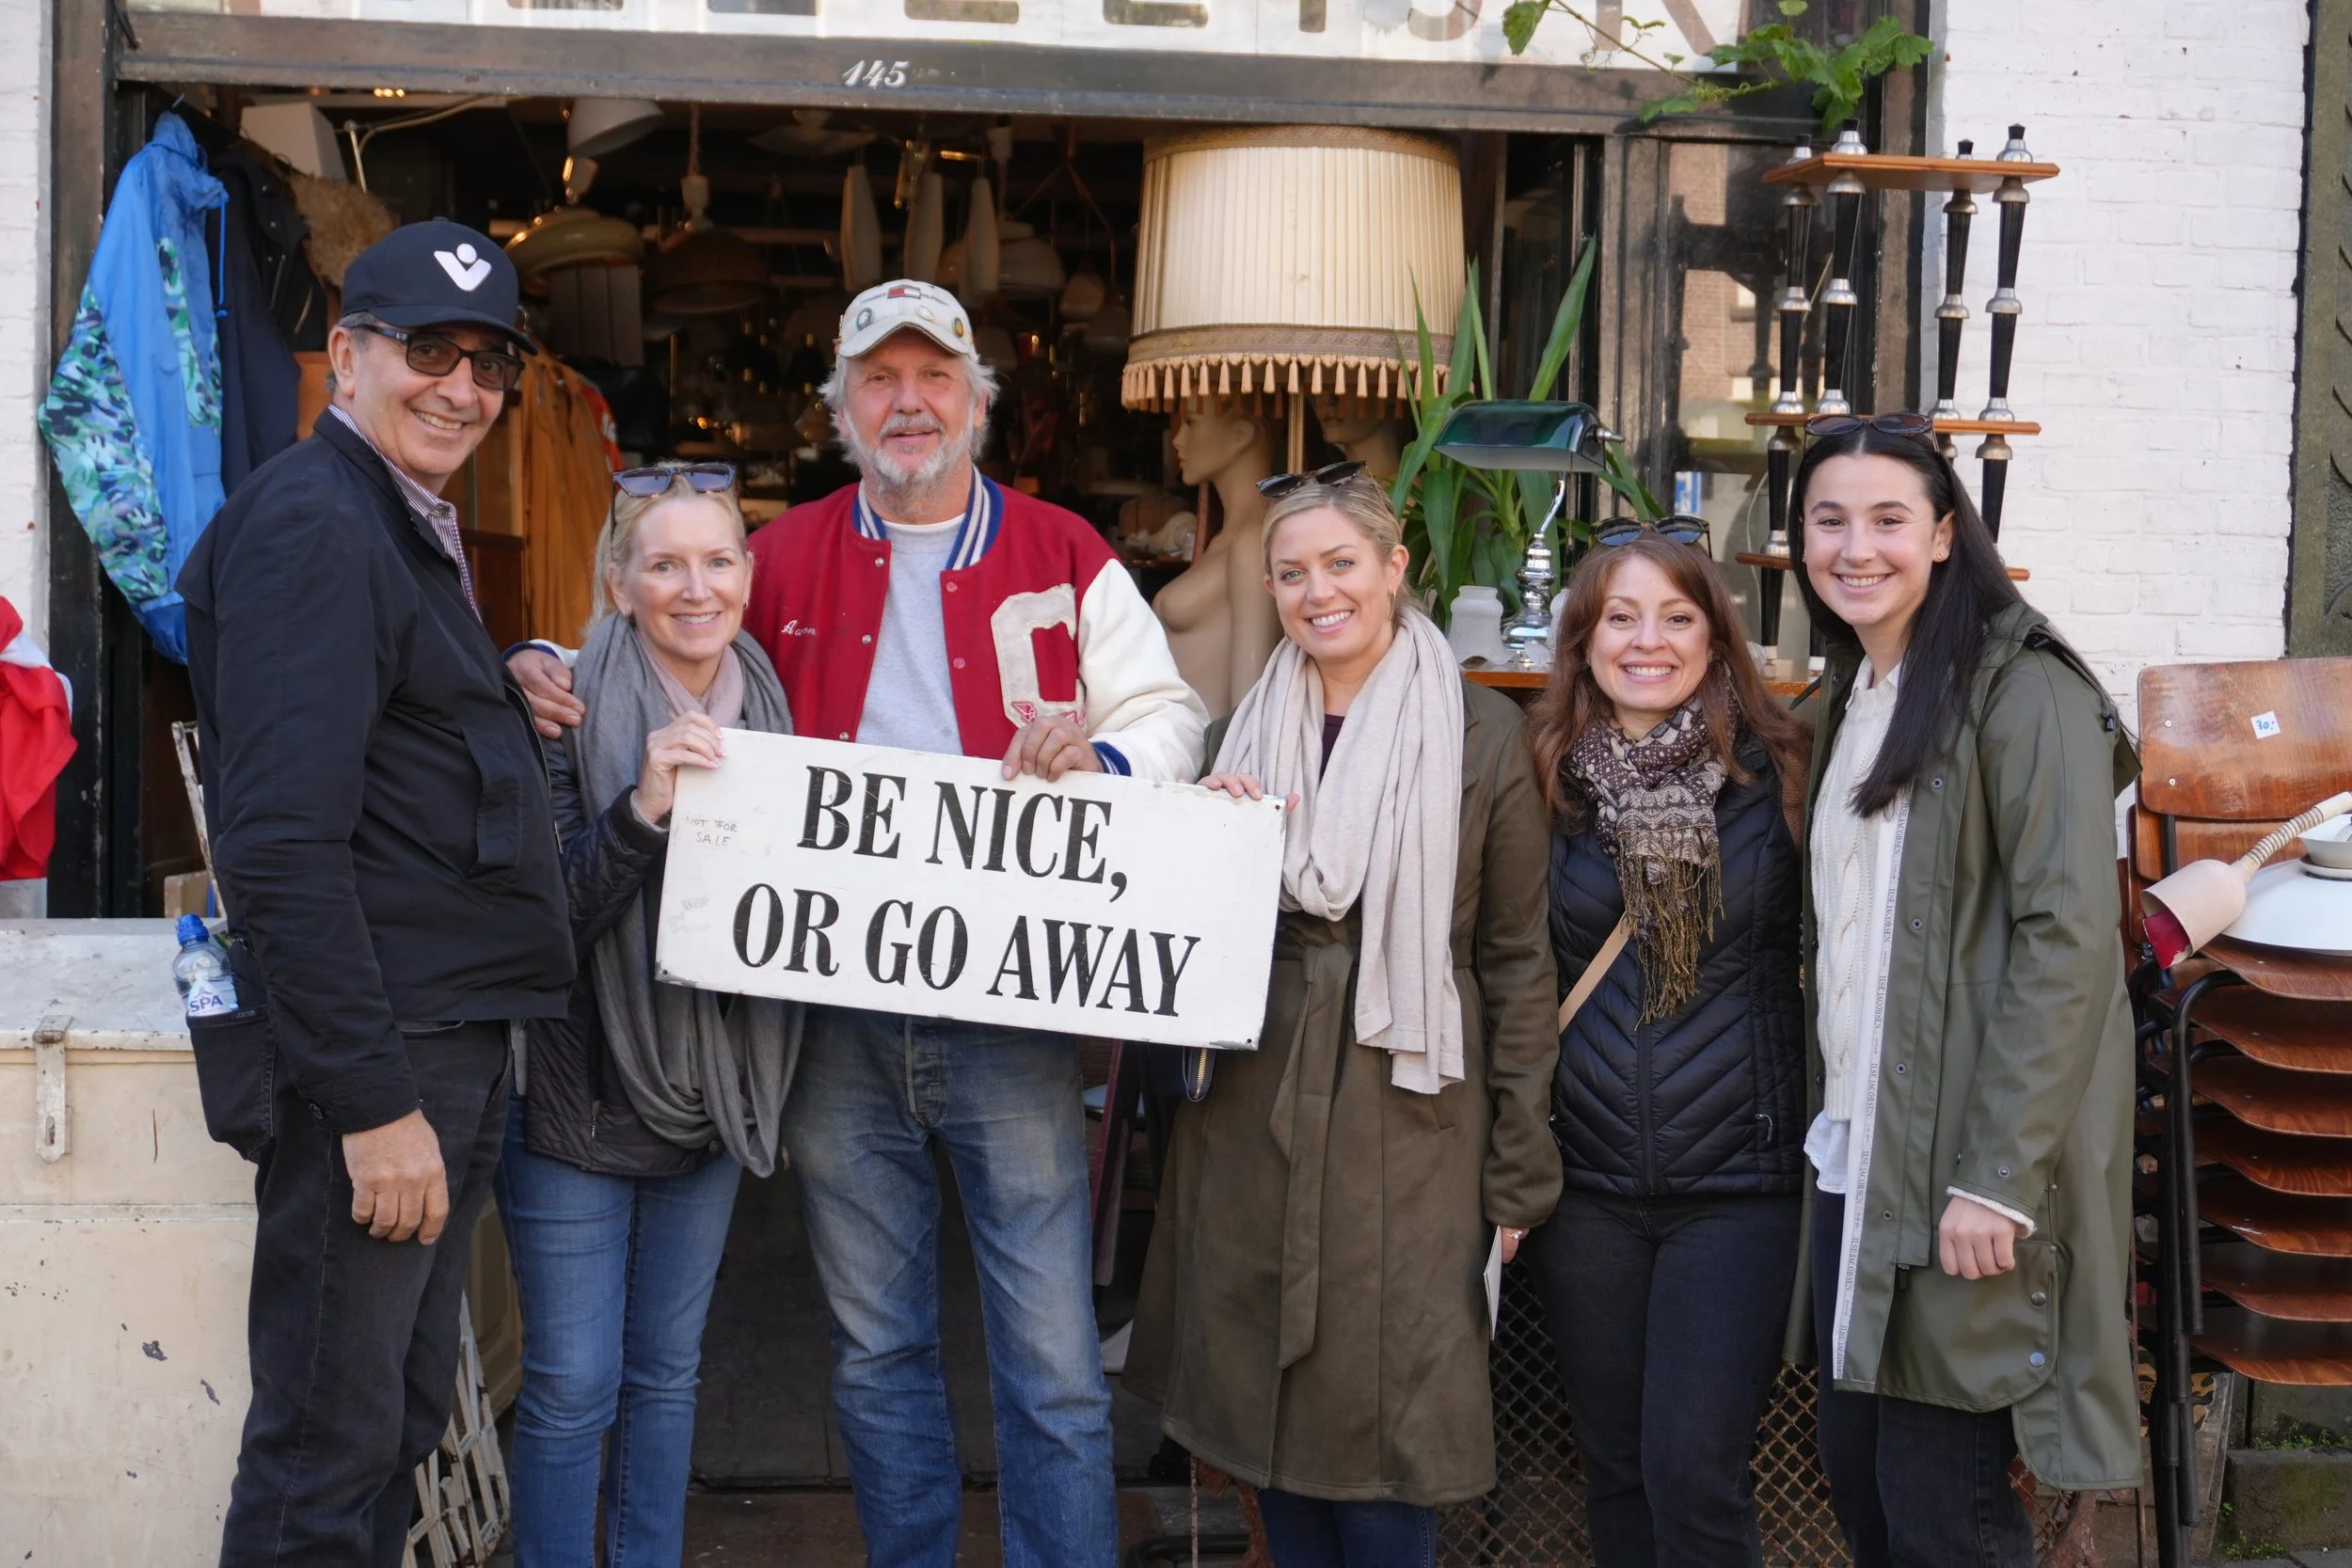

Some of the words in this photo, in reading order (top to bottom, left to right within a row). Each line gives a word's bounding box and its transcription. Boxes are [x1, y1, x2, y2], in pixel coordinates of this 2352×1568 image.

[842, 59, 911, 89] 145
[685, 816, 709, 827] NOT
[715, 819, 739, 832] FOR
[696, 832, 731, 847] SALE
[797, 765, 907, 860] BE
[925, 781, 1128, 903] NICE,
[1894, 818, 1906, 855] JACOBSEN
[1883, 905, 1894, 942] JACOBSEN
[732, 882, 840, 977] OR
[866, 899, 969, 990] GO
[986, 914, 1201, 1017] AWAY
[190, 995, 224, 1012] SPA
[1874, 991, 1884, 1030] JACOBSEN
[1866, 1079, 1876, 1117] JACOBSEN
[1855, 1166, 1867, 1204] JACOBSEN
[1846, 1254, 1857, 1291] JACOBSEN
